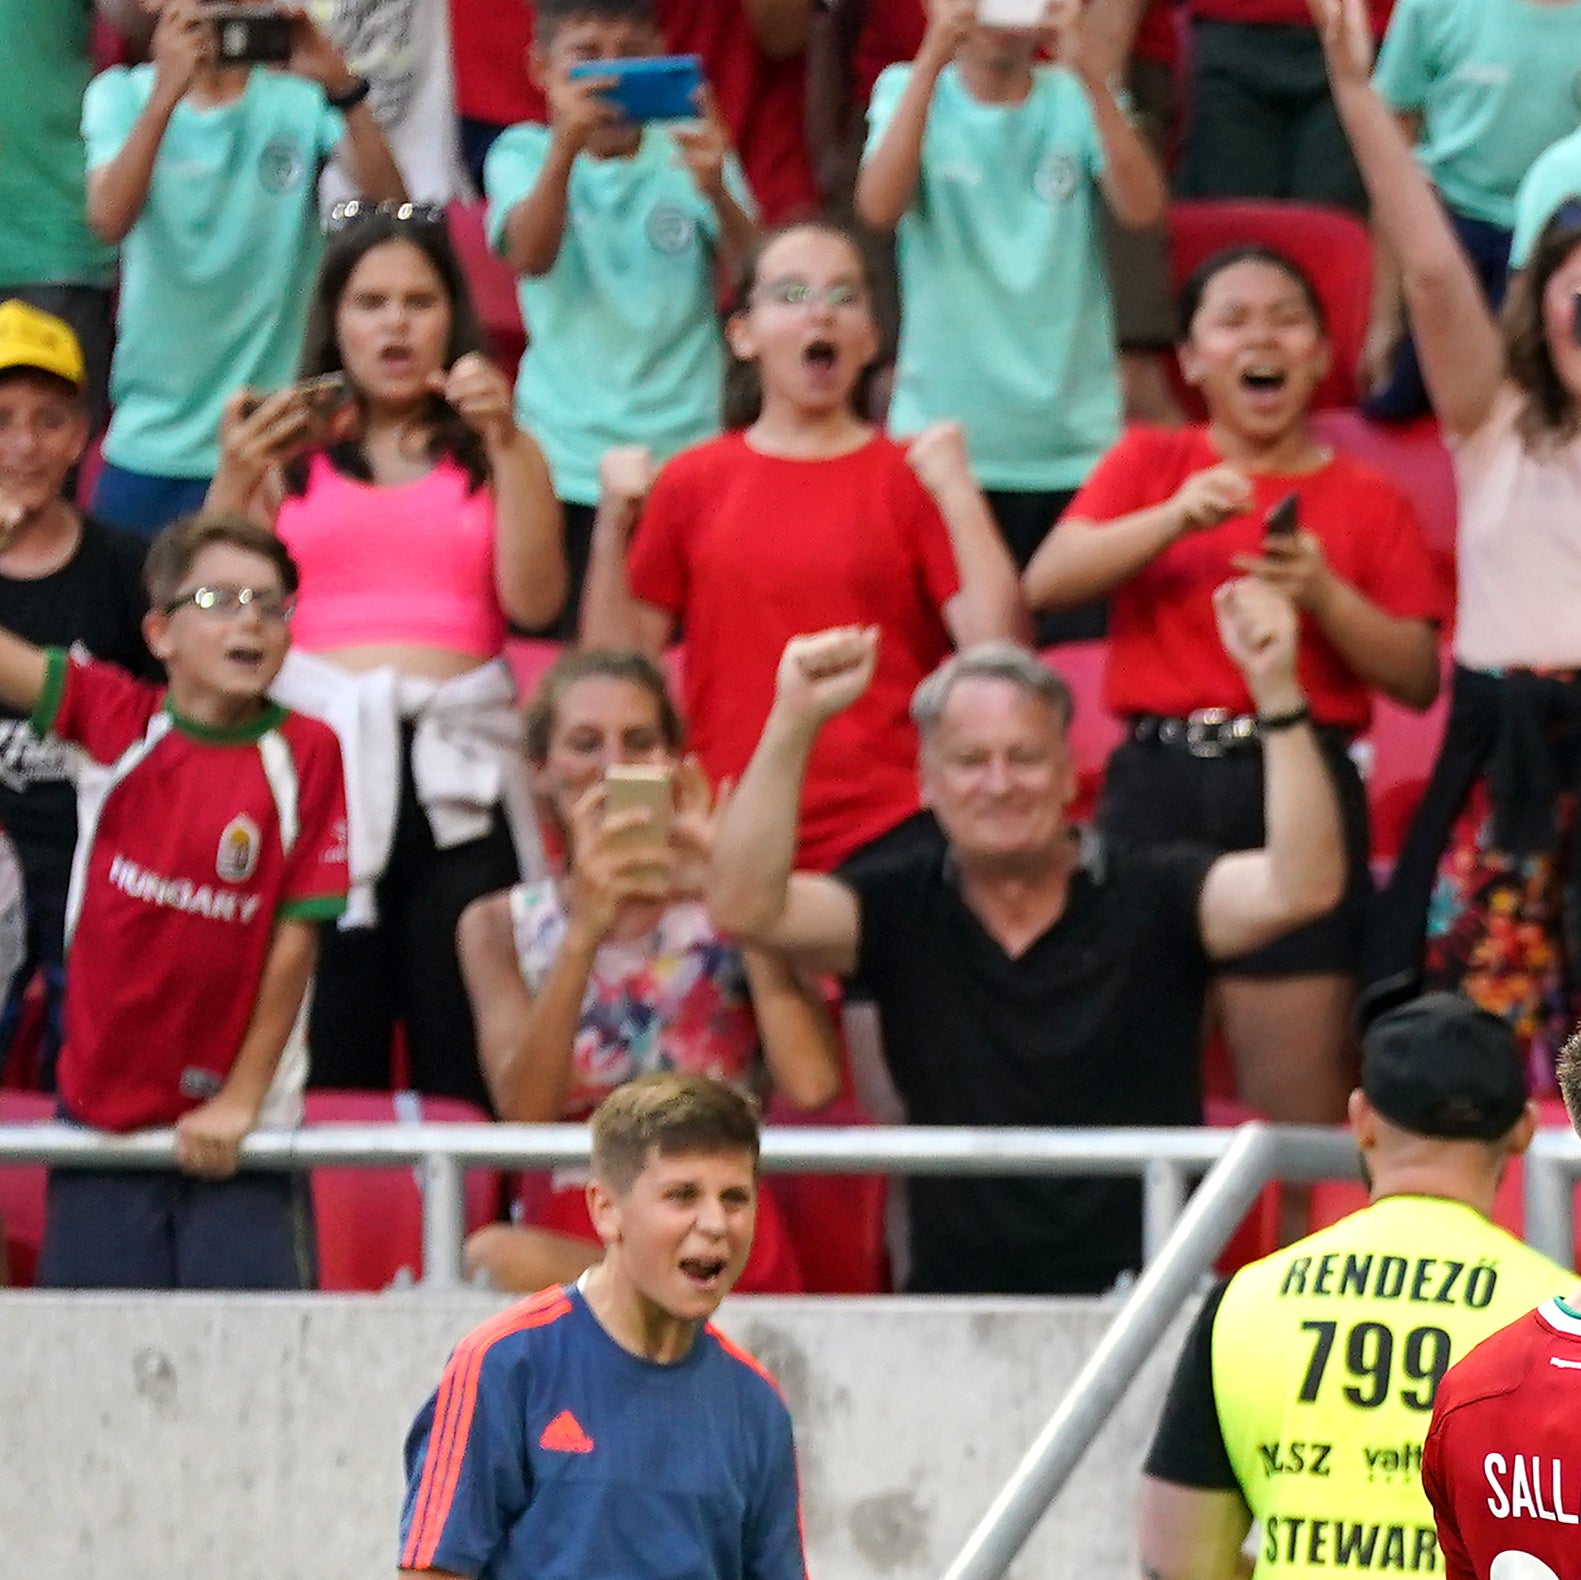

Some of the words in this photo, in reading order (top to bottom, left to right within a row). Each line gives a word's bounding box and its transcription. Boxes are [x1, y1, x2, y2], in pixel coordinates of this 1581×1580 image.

[108, 854, 261, 923] HUNGARY
[1281, 1253, 1499, 1309] RENDEZŐ
[1297, 1319, 1452, 1411] 799
[1266, 1516, 1444, 1573] STEWAR
